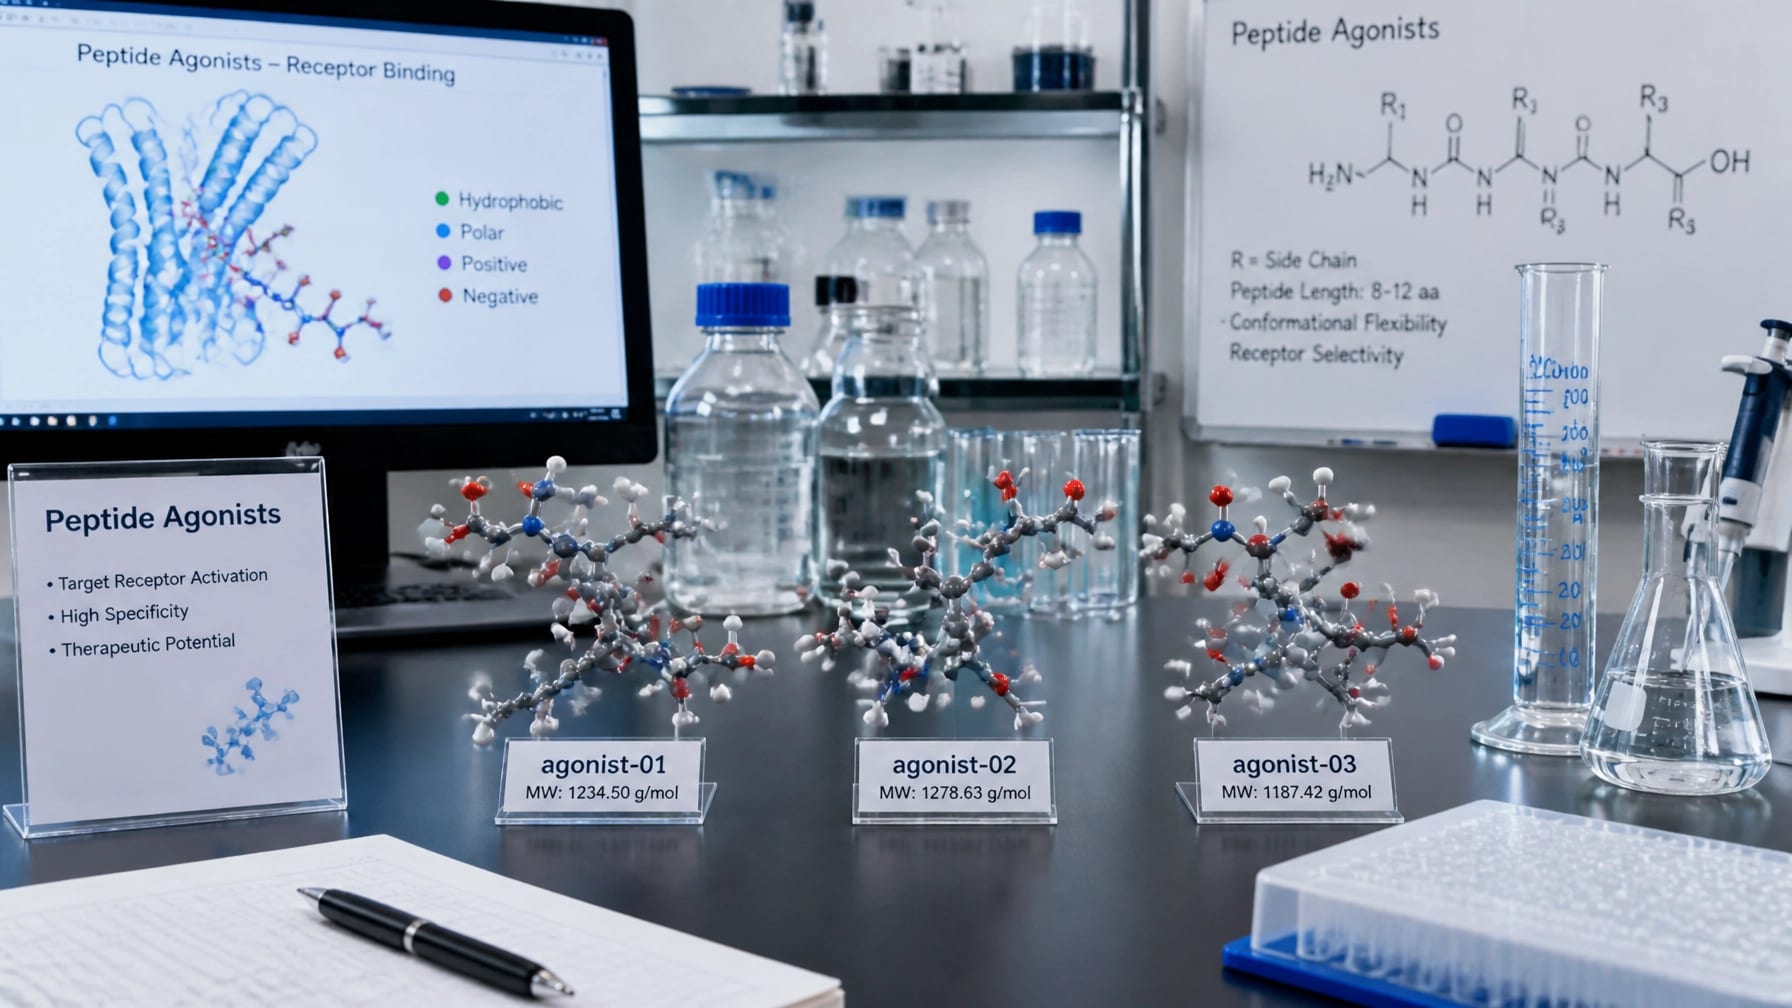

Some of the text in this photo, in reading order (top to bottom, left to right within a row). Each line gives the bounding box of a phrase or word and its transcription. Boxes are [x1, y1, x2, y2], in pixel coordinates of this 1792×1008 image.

[1232, 16, 1440, 51] Peptide Agonists
[77, 43, 161, 68] Peptide
[169, 48, 262, 73] Agonists
[286, 55, 377, 80] Receptor
[383, 62, 456, 87] Binding
[1640, 83, 1669, 113] R3
[1710, 148, 1750, 174] OH
[459, 191, 564, 212] Hydrophobic
[461, 223, 504, 241] Polar
[462, 255, 528, 273] Positive
[1231, 251, 1244, 269] R
[1265, 250, 1302, 269] Side
[1308, 250, 1358, 269] Chain
[463, 287, 539, 309] Negative
[1231, 280, 1440, 306] Peptide Length: 8-12 aa
[1230, 311, 1448, 338] Conformational Flexibility
[1230, 342, 1404, 370] Receptor Selectivity
[46, 502, 281, 537] Peptide Agonists
[58, 568, 268, 594] Target Receptor Activation
[61, 604, 189, 627] High Specificity
[61, 633, 236, 658] Therapeutic Potential
[541, 754, 666, 779] agonist-01
[893, 755, 1017, 779] agonist-02
[1233, 754, 1357, 779] agonist-03
[526, 786, 679, 803] MW: 1234.50 g/mol
[879, 785, 1031, 803] MW: 1278.63 g/mol
[1222, 785, 1372, 802] MW: 1187.42 g/mol
